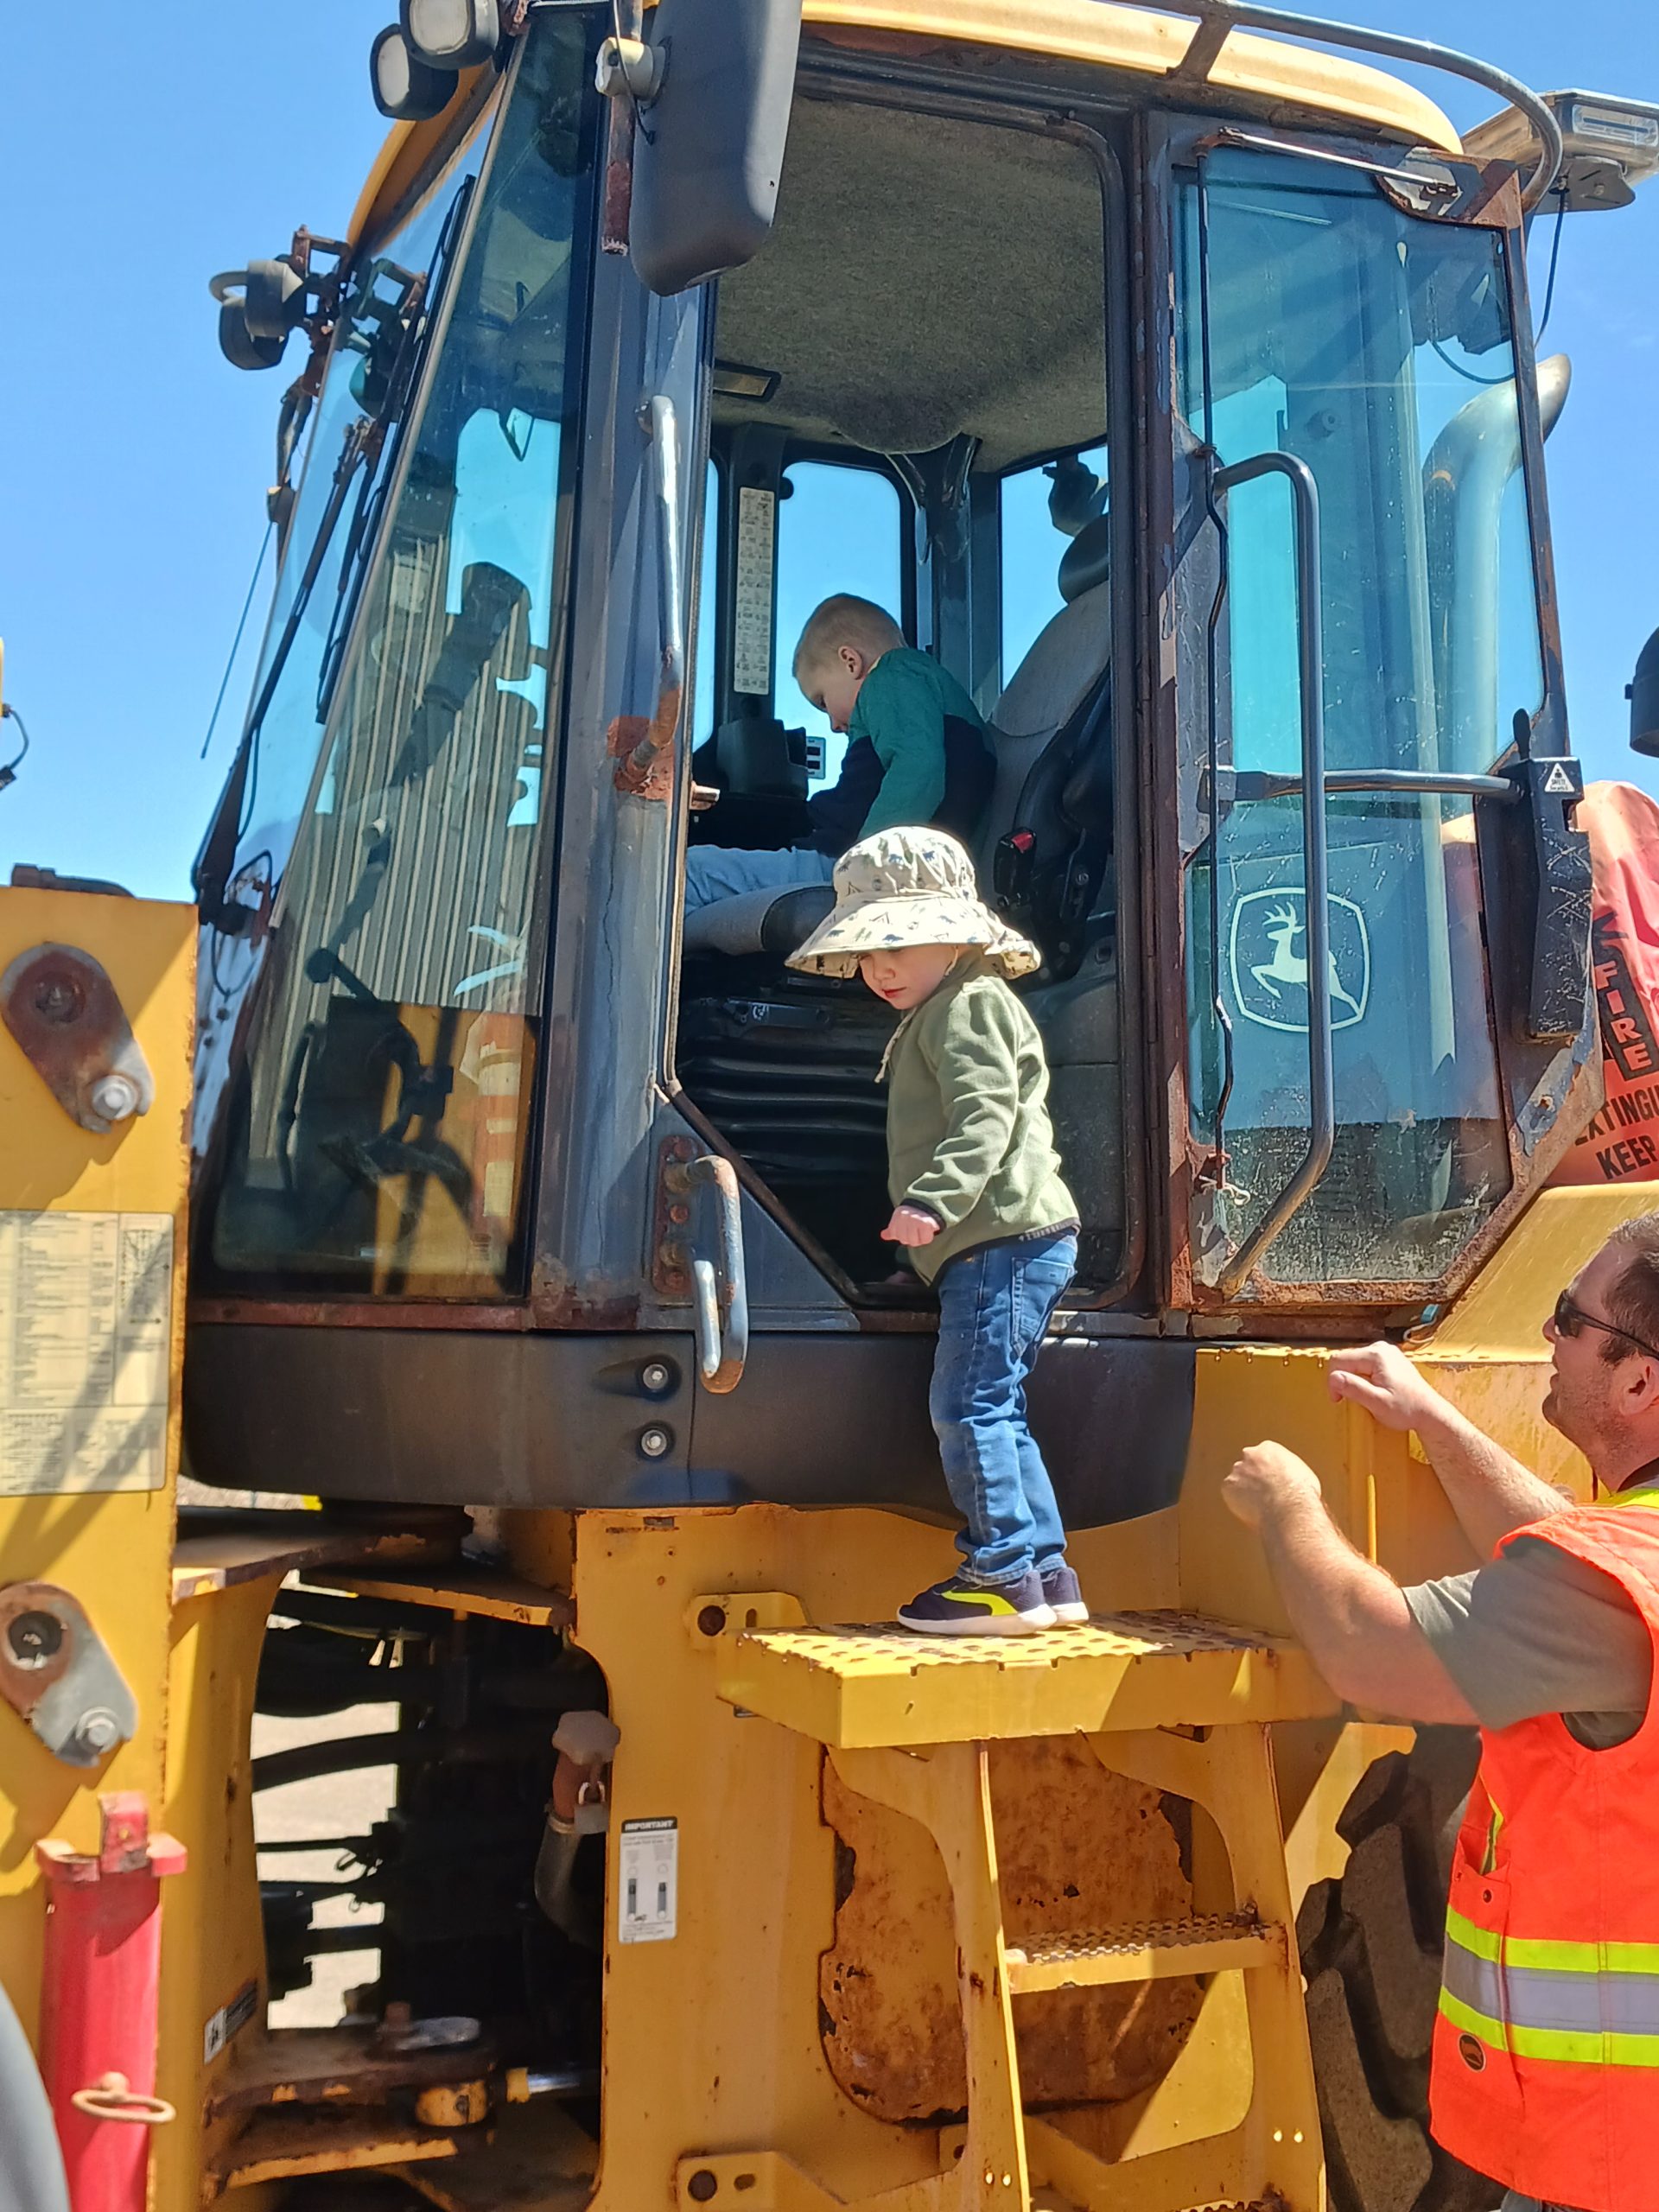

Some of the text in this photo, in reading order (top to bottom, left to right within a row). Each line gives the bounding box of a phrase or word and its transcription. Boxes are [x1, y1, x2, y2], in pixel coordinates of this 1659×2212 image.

[1594, 960, 1652, 1071] FIRE
[1574, 1084, 1659, 1146] XTINGU
[1596, 1135, 1658, 1180] KEEP
